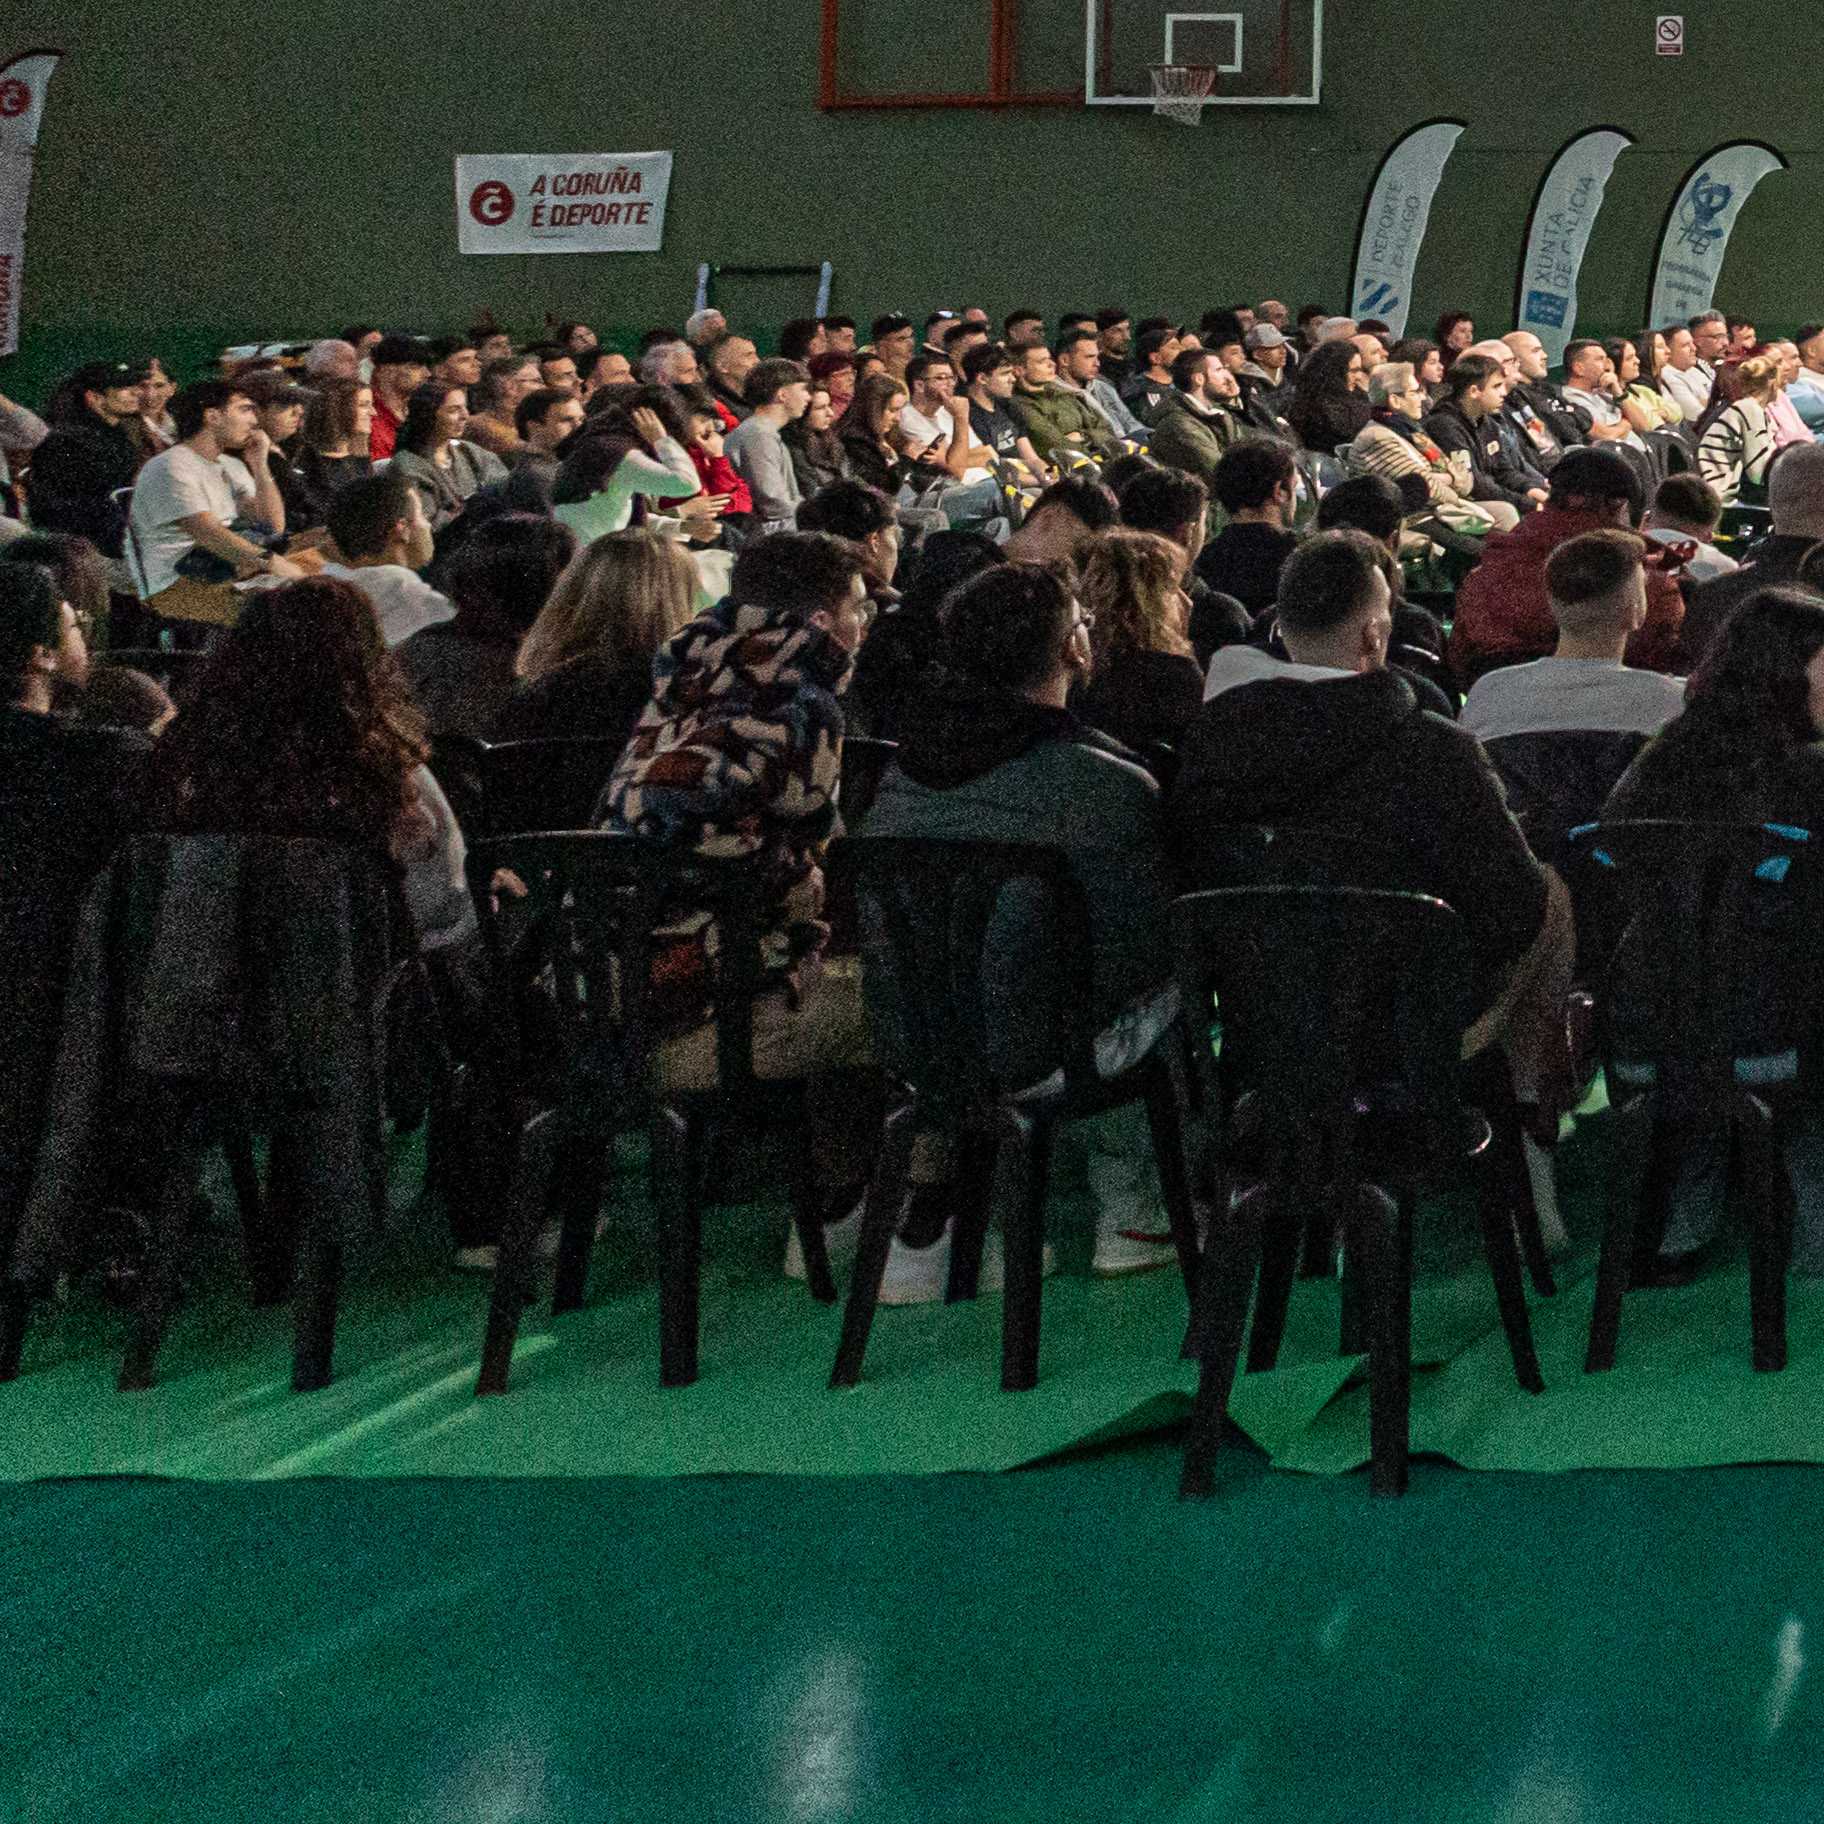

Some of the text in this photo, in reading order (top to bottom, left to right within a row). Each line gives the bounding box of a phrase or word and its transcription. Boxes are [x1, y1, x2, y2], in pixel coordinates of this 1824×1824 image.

[530, 166, 642, 197] A CORUÑA
[531, 200, 653, 227] É DEPORTE
[1534, 212, 1565, 283] XUNTA
[1553, 264, 1573, 289] DE
